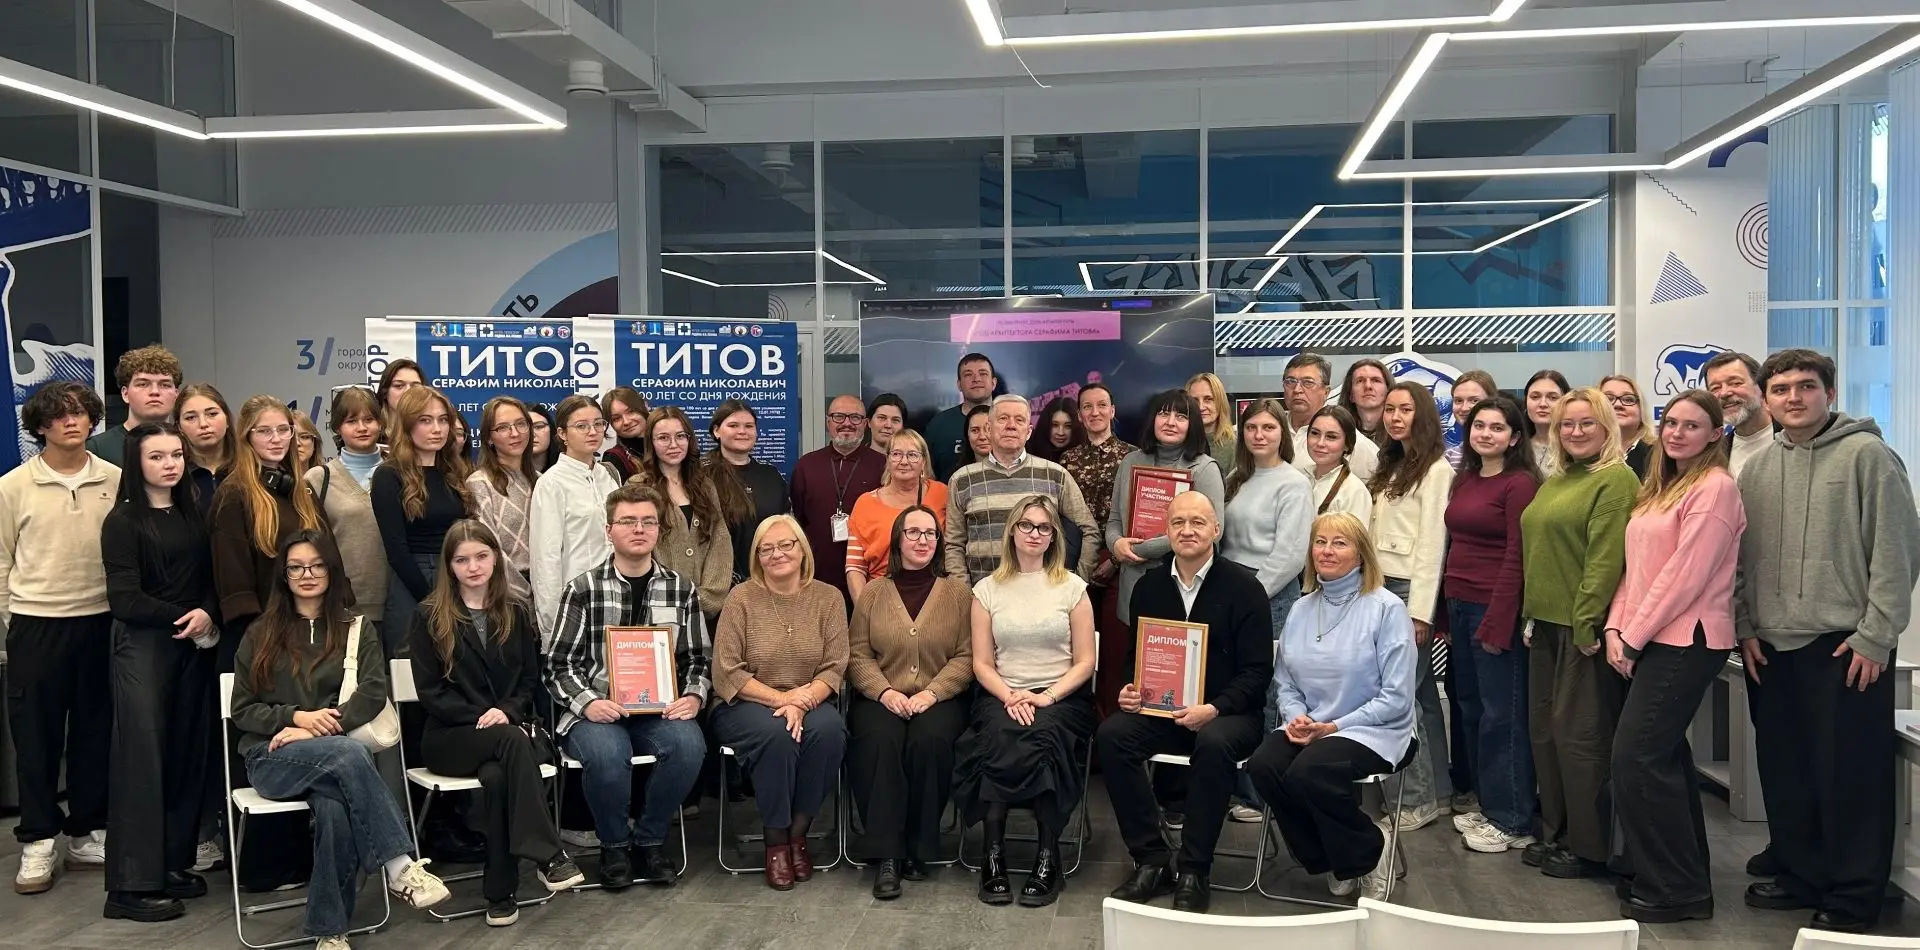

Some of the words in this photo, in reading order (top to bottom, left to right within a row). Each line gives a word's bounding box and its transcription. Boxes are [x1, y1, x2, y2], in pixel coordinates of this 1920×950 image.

[431, 345, 574, 376] ТИТО
[631, 342, 785, 376] ТИТОВ
[432, 378, 500, 388] СЕРАФИМ
[632, 378, 696, 388] СЕРАФИМ
[699, 378, 786, 388] НИКОЛАЕВИЧ
[656, 391, 676, 401] ЛЕТ
[678, 391, 697, 401] СО
[699, 391, 722, 402] ДНЯ
[725, 391, 787, 402] РОЖДЕНИЯ
[457, 402, 478, 412] ЛЕТ
[1141, 485, 1166, 495] ДИПЛОМ
[616, 641, 655, 650] ДИПЛОМ
[1147, 635, 1187, 647] ДИПЛОМ
